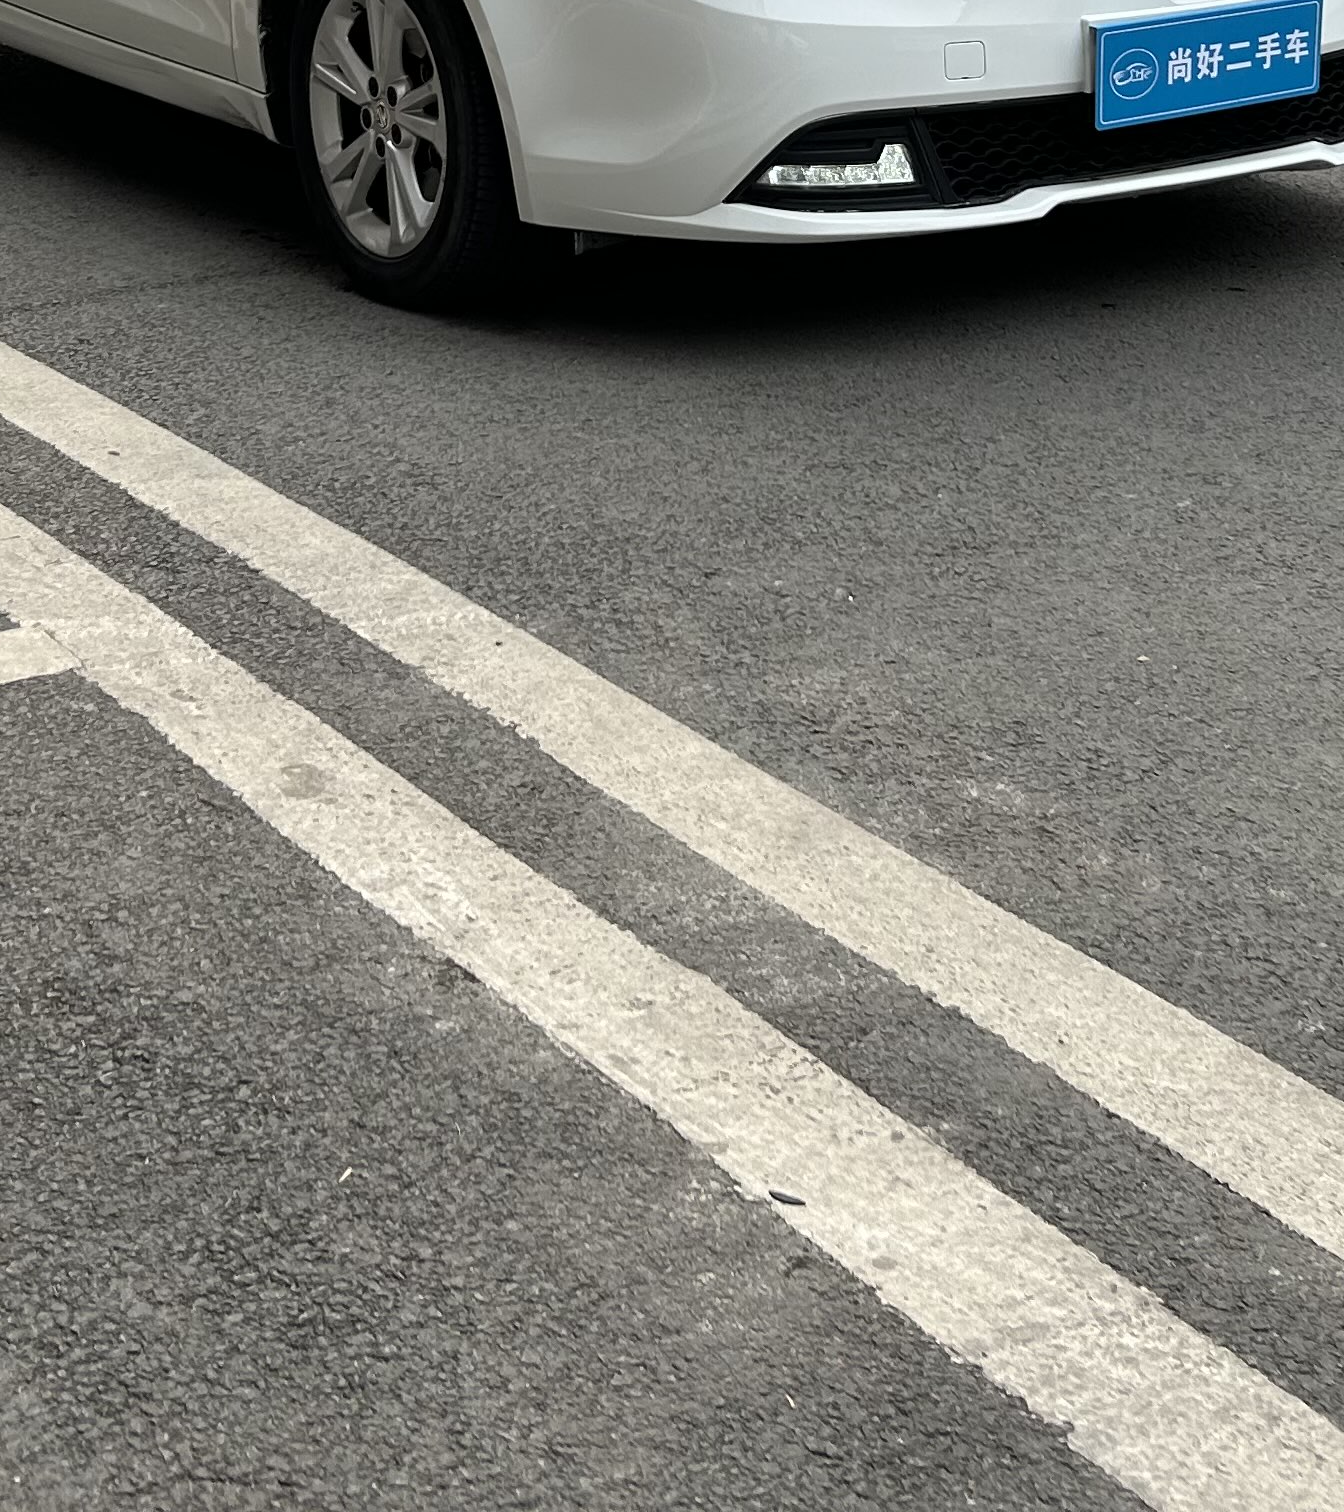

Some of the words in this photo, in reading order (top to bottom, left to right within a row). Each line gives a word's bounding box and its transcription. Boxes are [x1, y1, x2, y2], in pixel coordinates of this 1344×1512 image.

[1167, 28, 1310, 85] 尚好二手车
